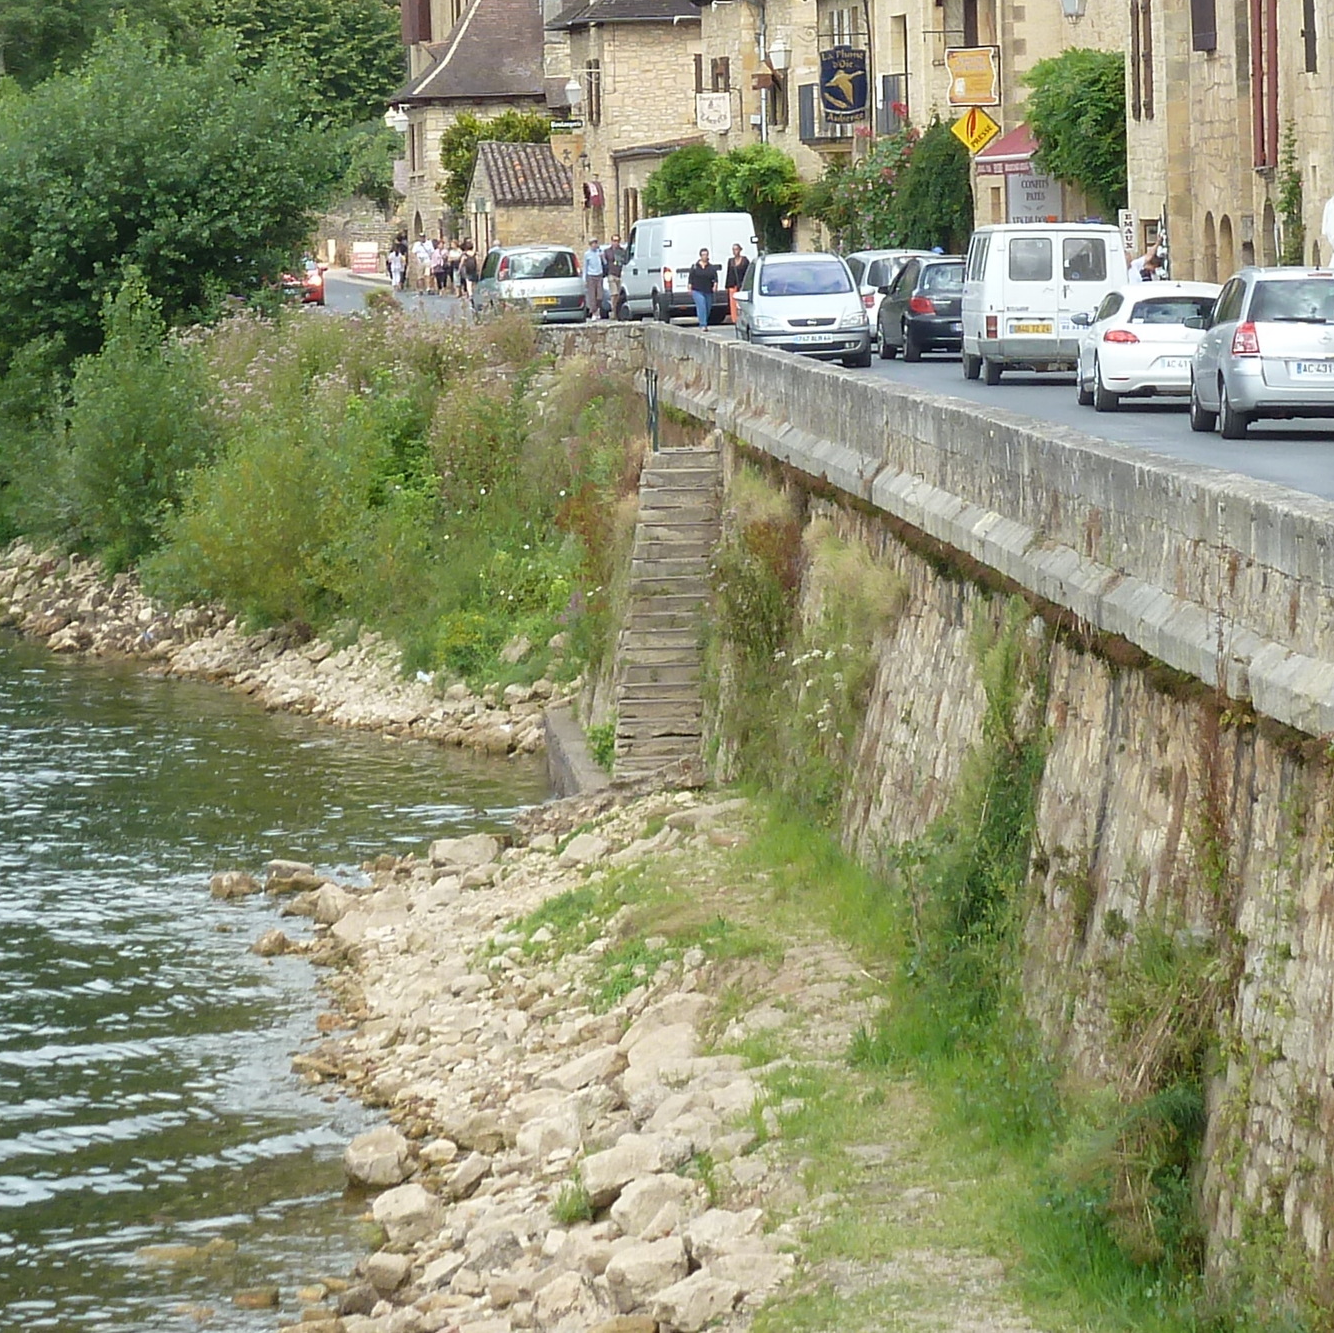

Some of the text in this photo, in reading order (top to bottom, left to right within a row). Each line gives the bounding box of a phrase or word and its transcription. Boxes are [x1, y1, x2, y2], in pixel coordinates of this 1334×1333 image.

[970, 124, 993, 148] PRESSE
[1021, 179, 1049, 189] CONFITS
[1123, 213, 1133, 249] EMAUX
